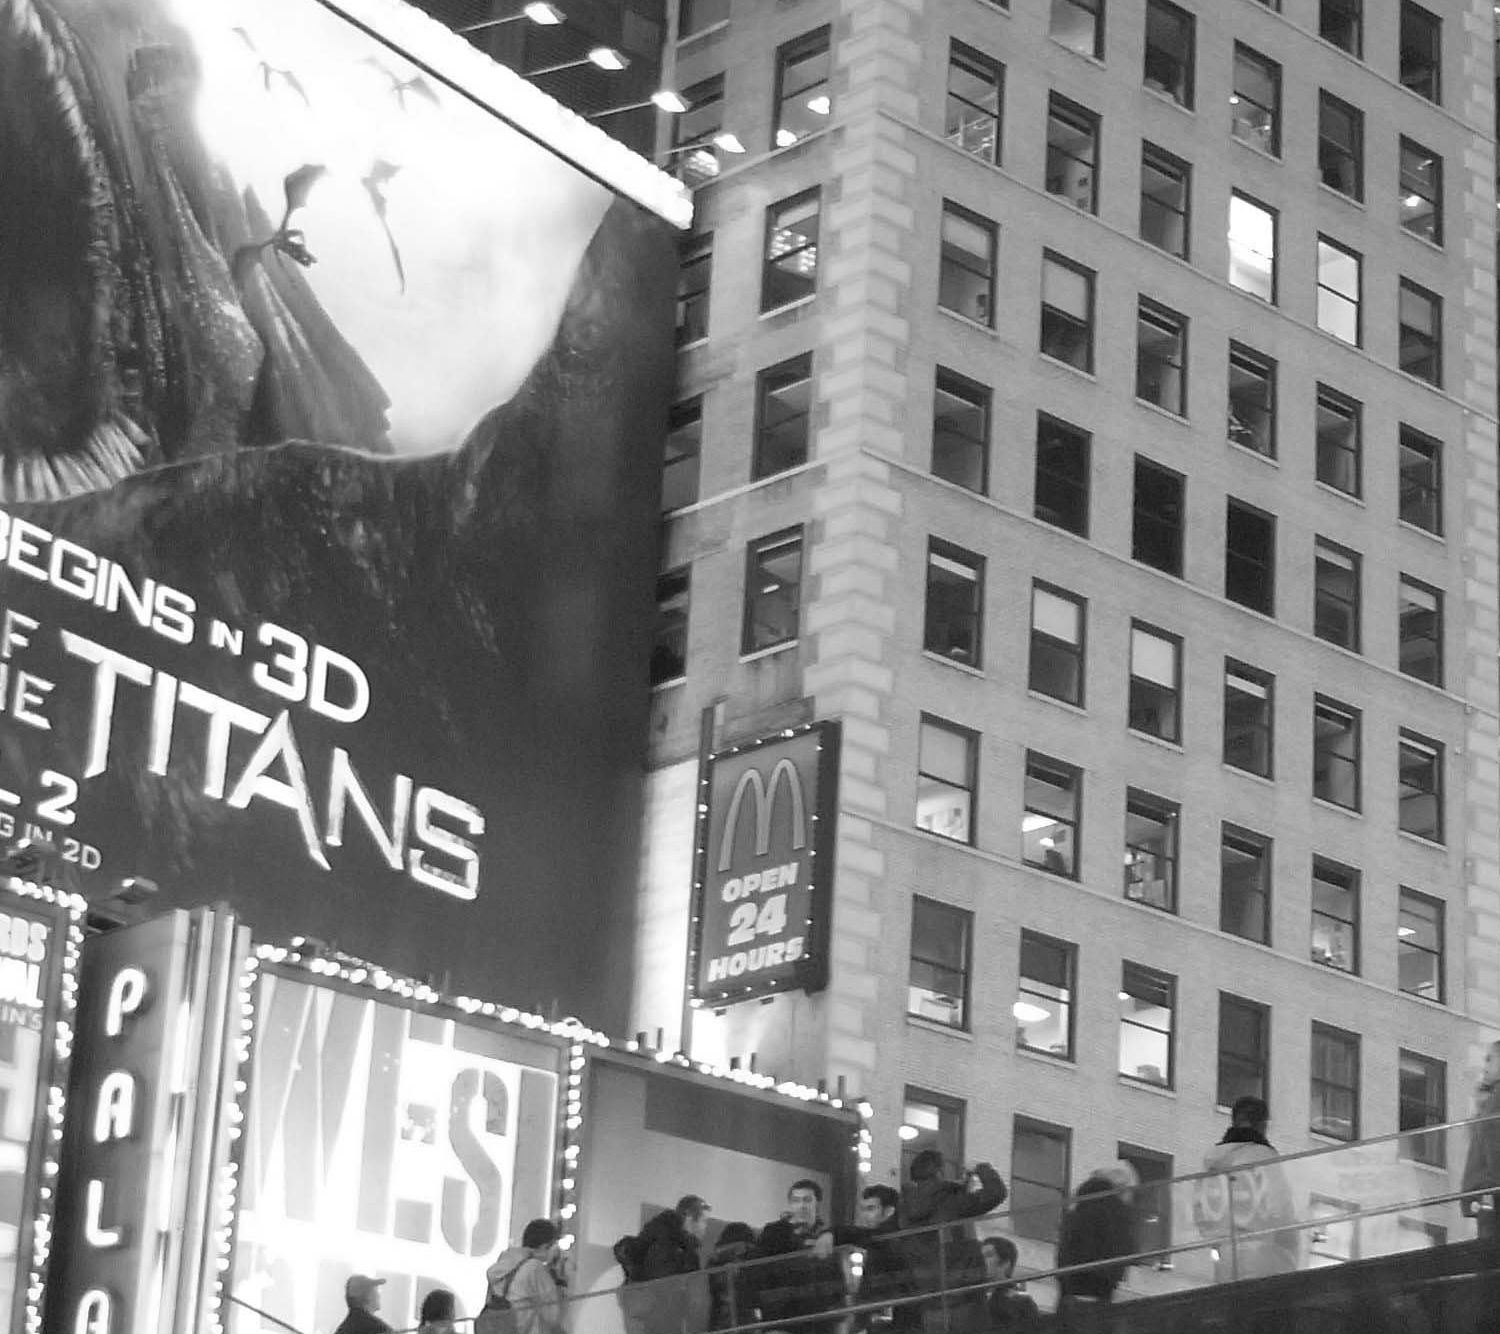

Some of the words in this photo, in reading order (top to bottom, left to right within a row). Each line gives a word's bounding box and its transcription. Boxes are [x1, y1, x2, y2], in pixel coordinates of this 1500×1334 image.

[0, 663, 56, 730] E
[210, 620, 244, 655] IN
[252, 622, 370, 723] 3D
[60, 628, 486, 899] TITANS
[36, 770, 79, 825] 2
[62, 837, 102, 870] 2D
[722, 862, 799, 902] OPEN
[728, 894, 788, 946] 24
[708, 936, 805, 982] HOURS
